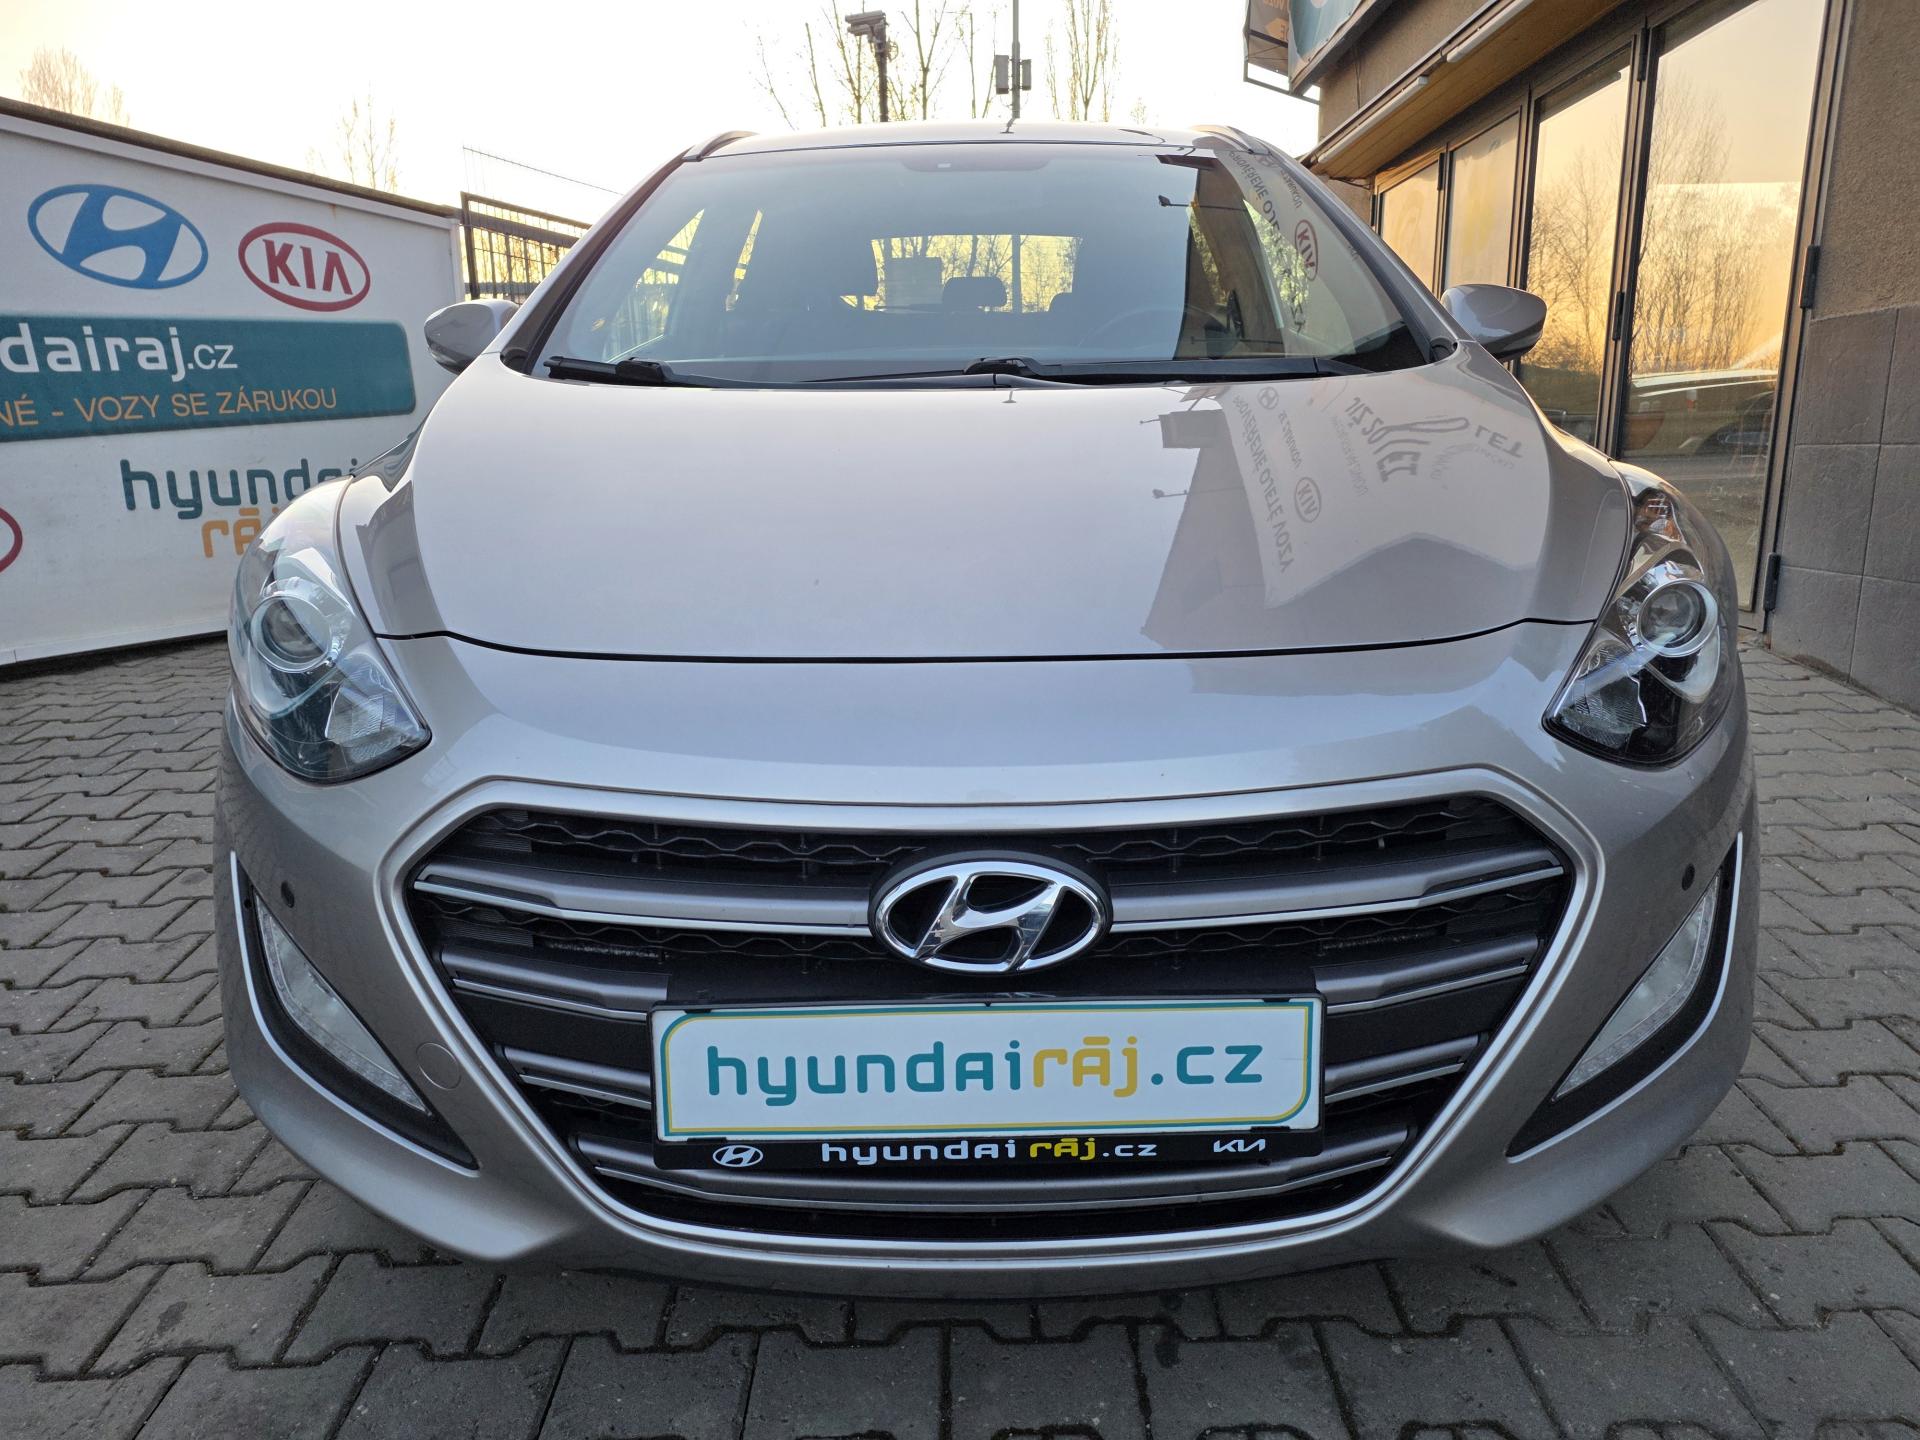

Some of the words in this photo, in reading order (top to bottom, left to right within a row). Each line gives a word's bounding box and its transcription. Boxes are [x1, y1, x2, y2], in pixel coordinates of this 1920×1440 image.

[262, 238, 354, 296] KIA
[73, 394, 160, 423] VOZY
[171, 392, 210, 418] SE
[215, 385, 338, 415] ZÁRUKOU
[1212, 1138, 1267, 1154] KIA
